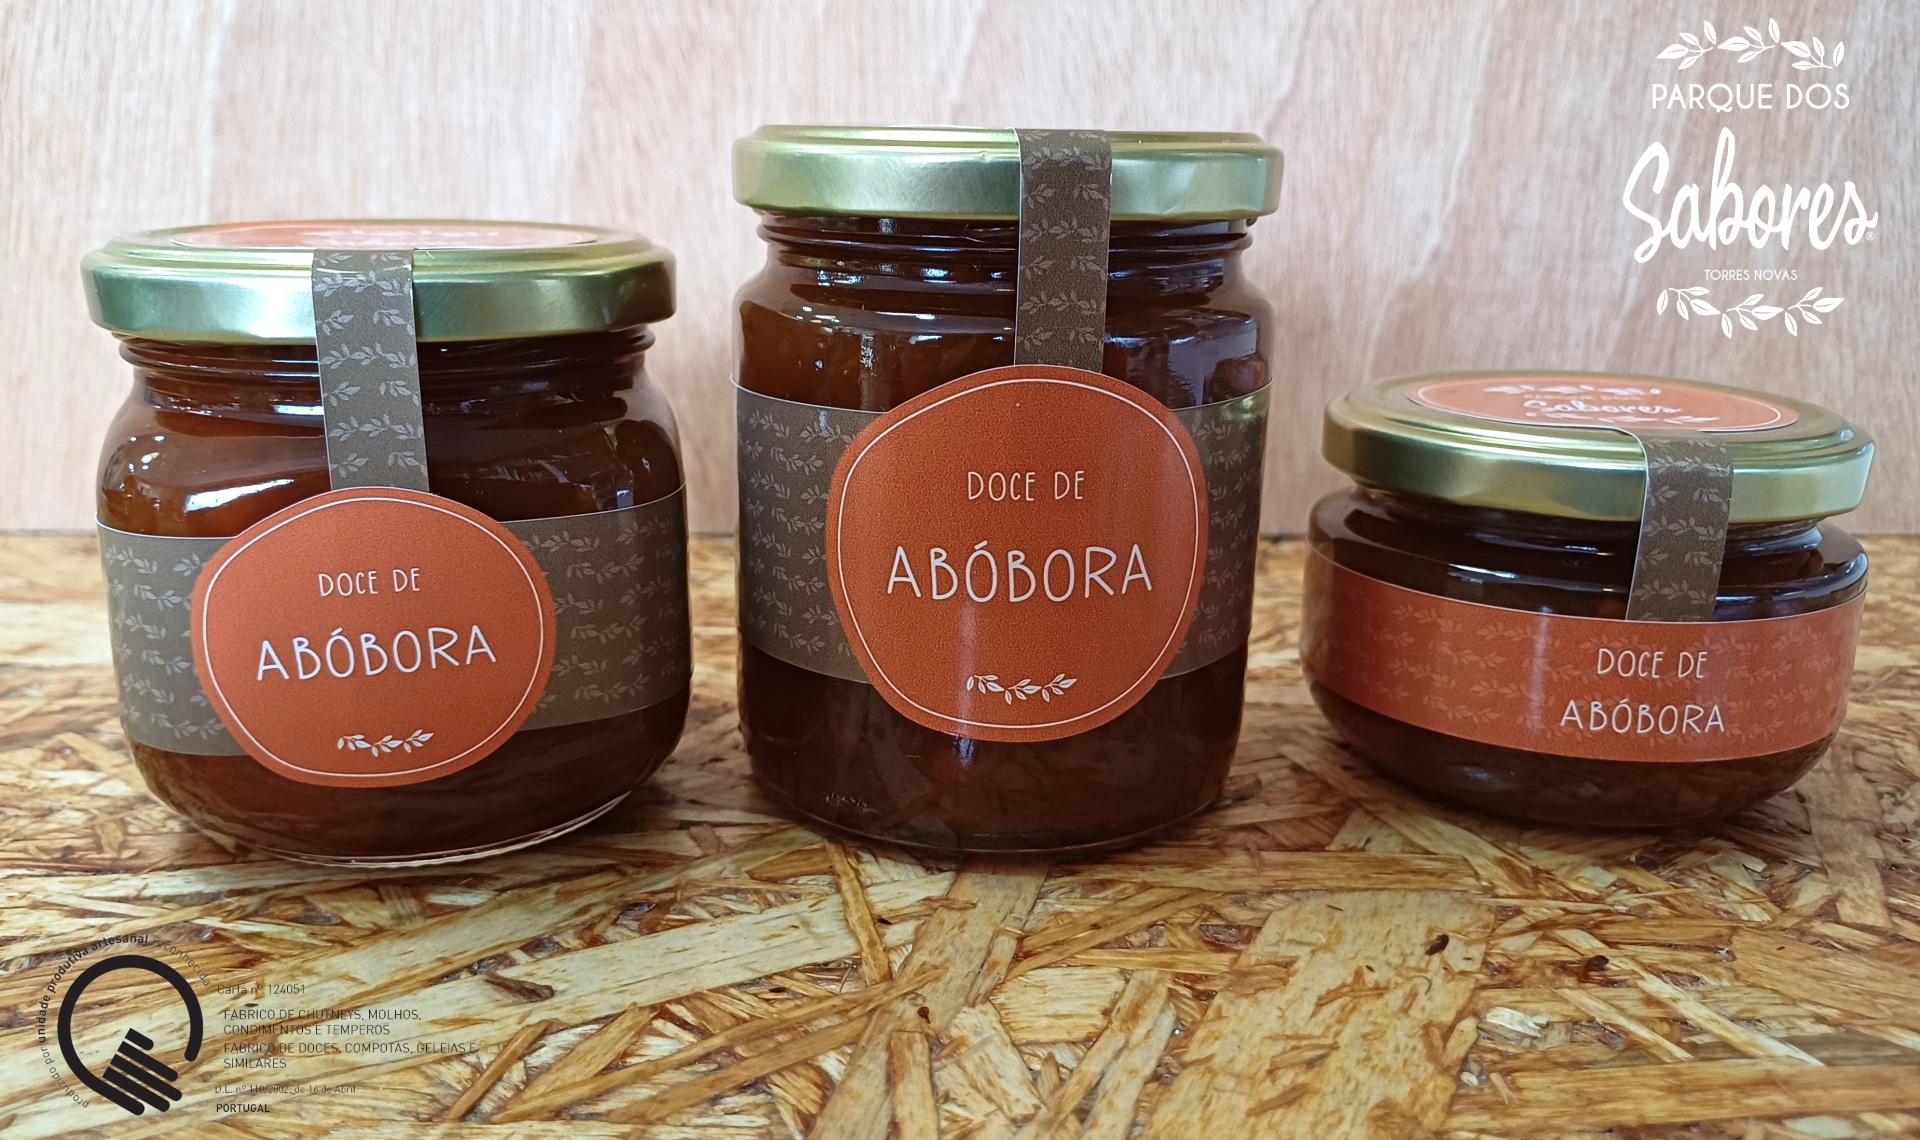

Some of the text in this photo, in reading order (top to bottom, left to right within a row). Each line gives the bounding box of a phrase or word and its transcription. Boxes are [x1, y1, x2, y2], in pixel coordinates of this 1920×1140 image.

[967, 470, 1085, 501] DOCE DE
[318, 567, 421, 597] DOCE DE
[887, 540, 1153, 603] ABÓBORA
[256, 624, 497, 682] ABÓBORA
[1597, 648, 1708, 679] DOCE DE
[1560, 698, 1725, 735] ABÓBORA
